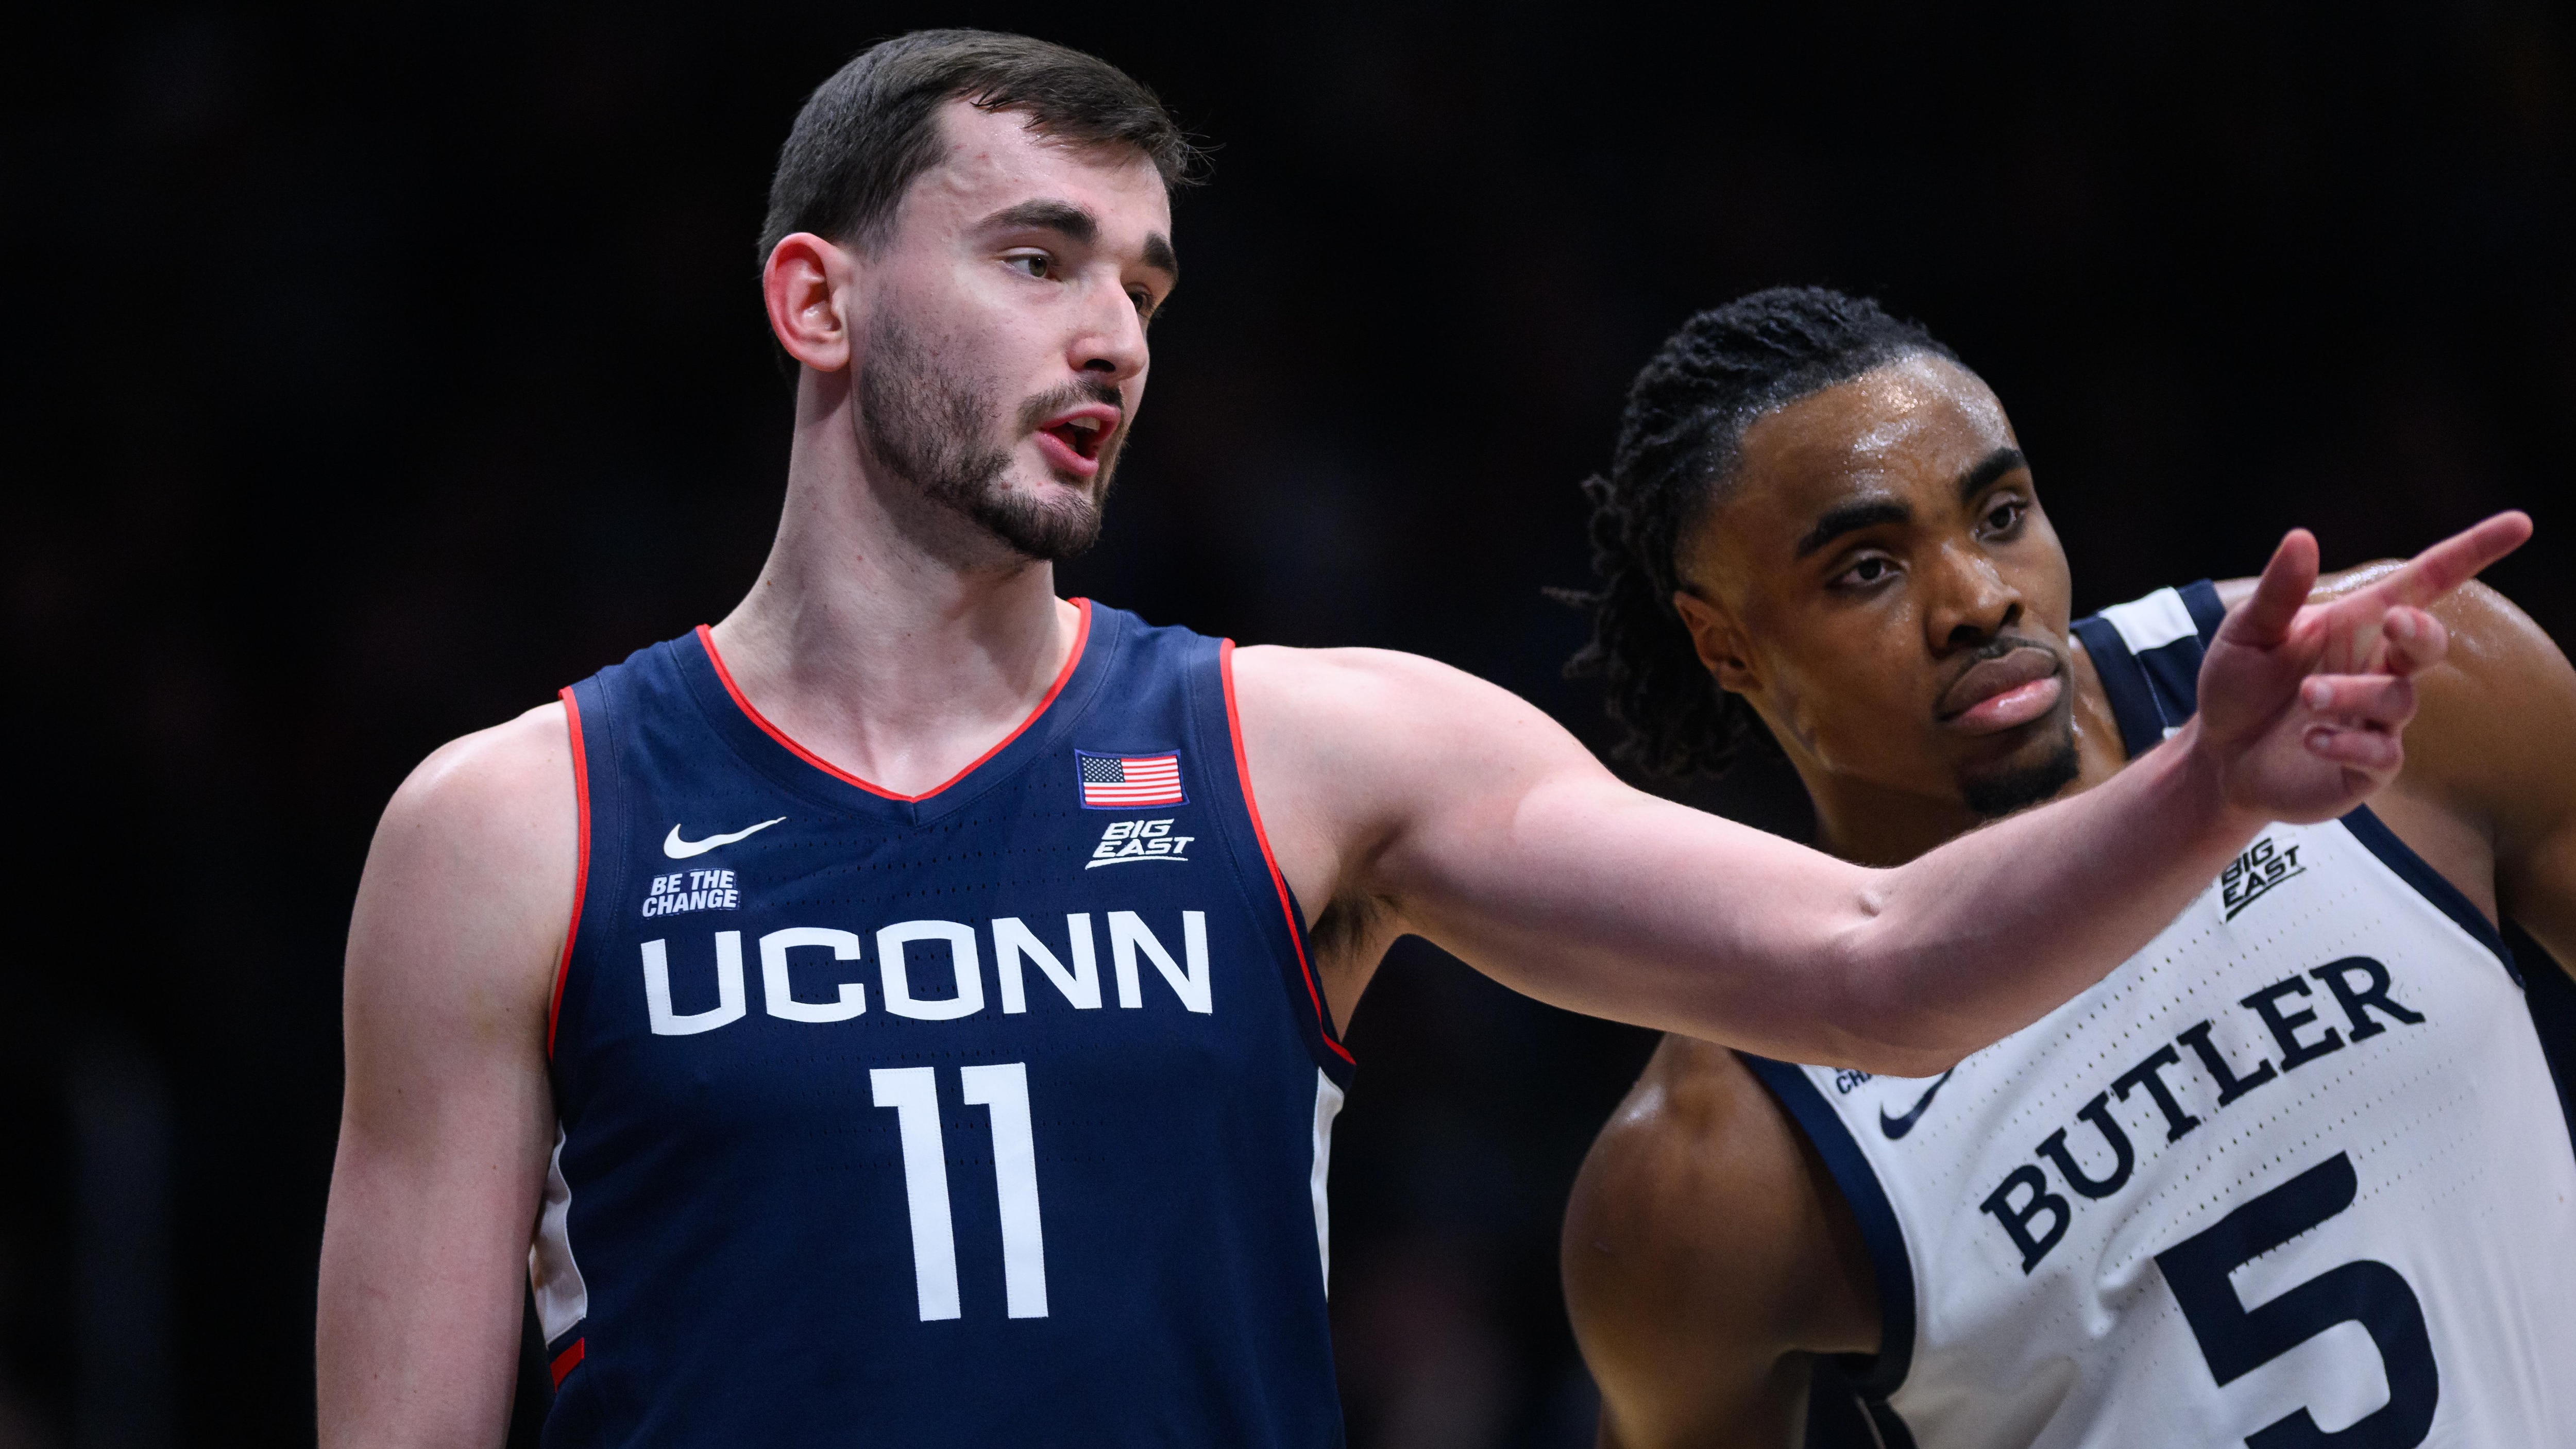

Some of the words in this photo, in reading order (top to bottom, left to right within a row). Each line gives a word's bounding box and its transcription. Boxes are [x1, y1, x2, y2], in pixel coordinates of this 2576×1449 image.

[1093, 837, 1195, 857] EAST
[1101, 818, 1174, 840] BIG
[651, 873, 683, 896] BE
[690, 870, 734, 890] THE
[2221, 836, 2274, 885] BIG
[2223, 845, 2299, 908] EAST
[642, 889, 738, 917] CHANGE
[641, 911, 1213, 1036] UCONN
[1979, 956, 2426, 1276] BUTLER
[870, 1062, 1048, 1322] 11
[2154, 1150, 2439, 1449] 5
